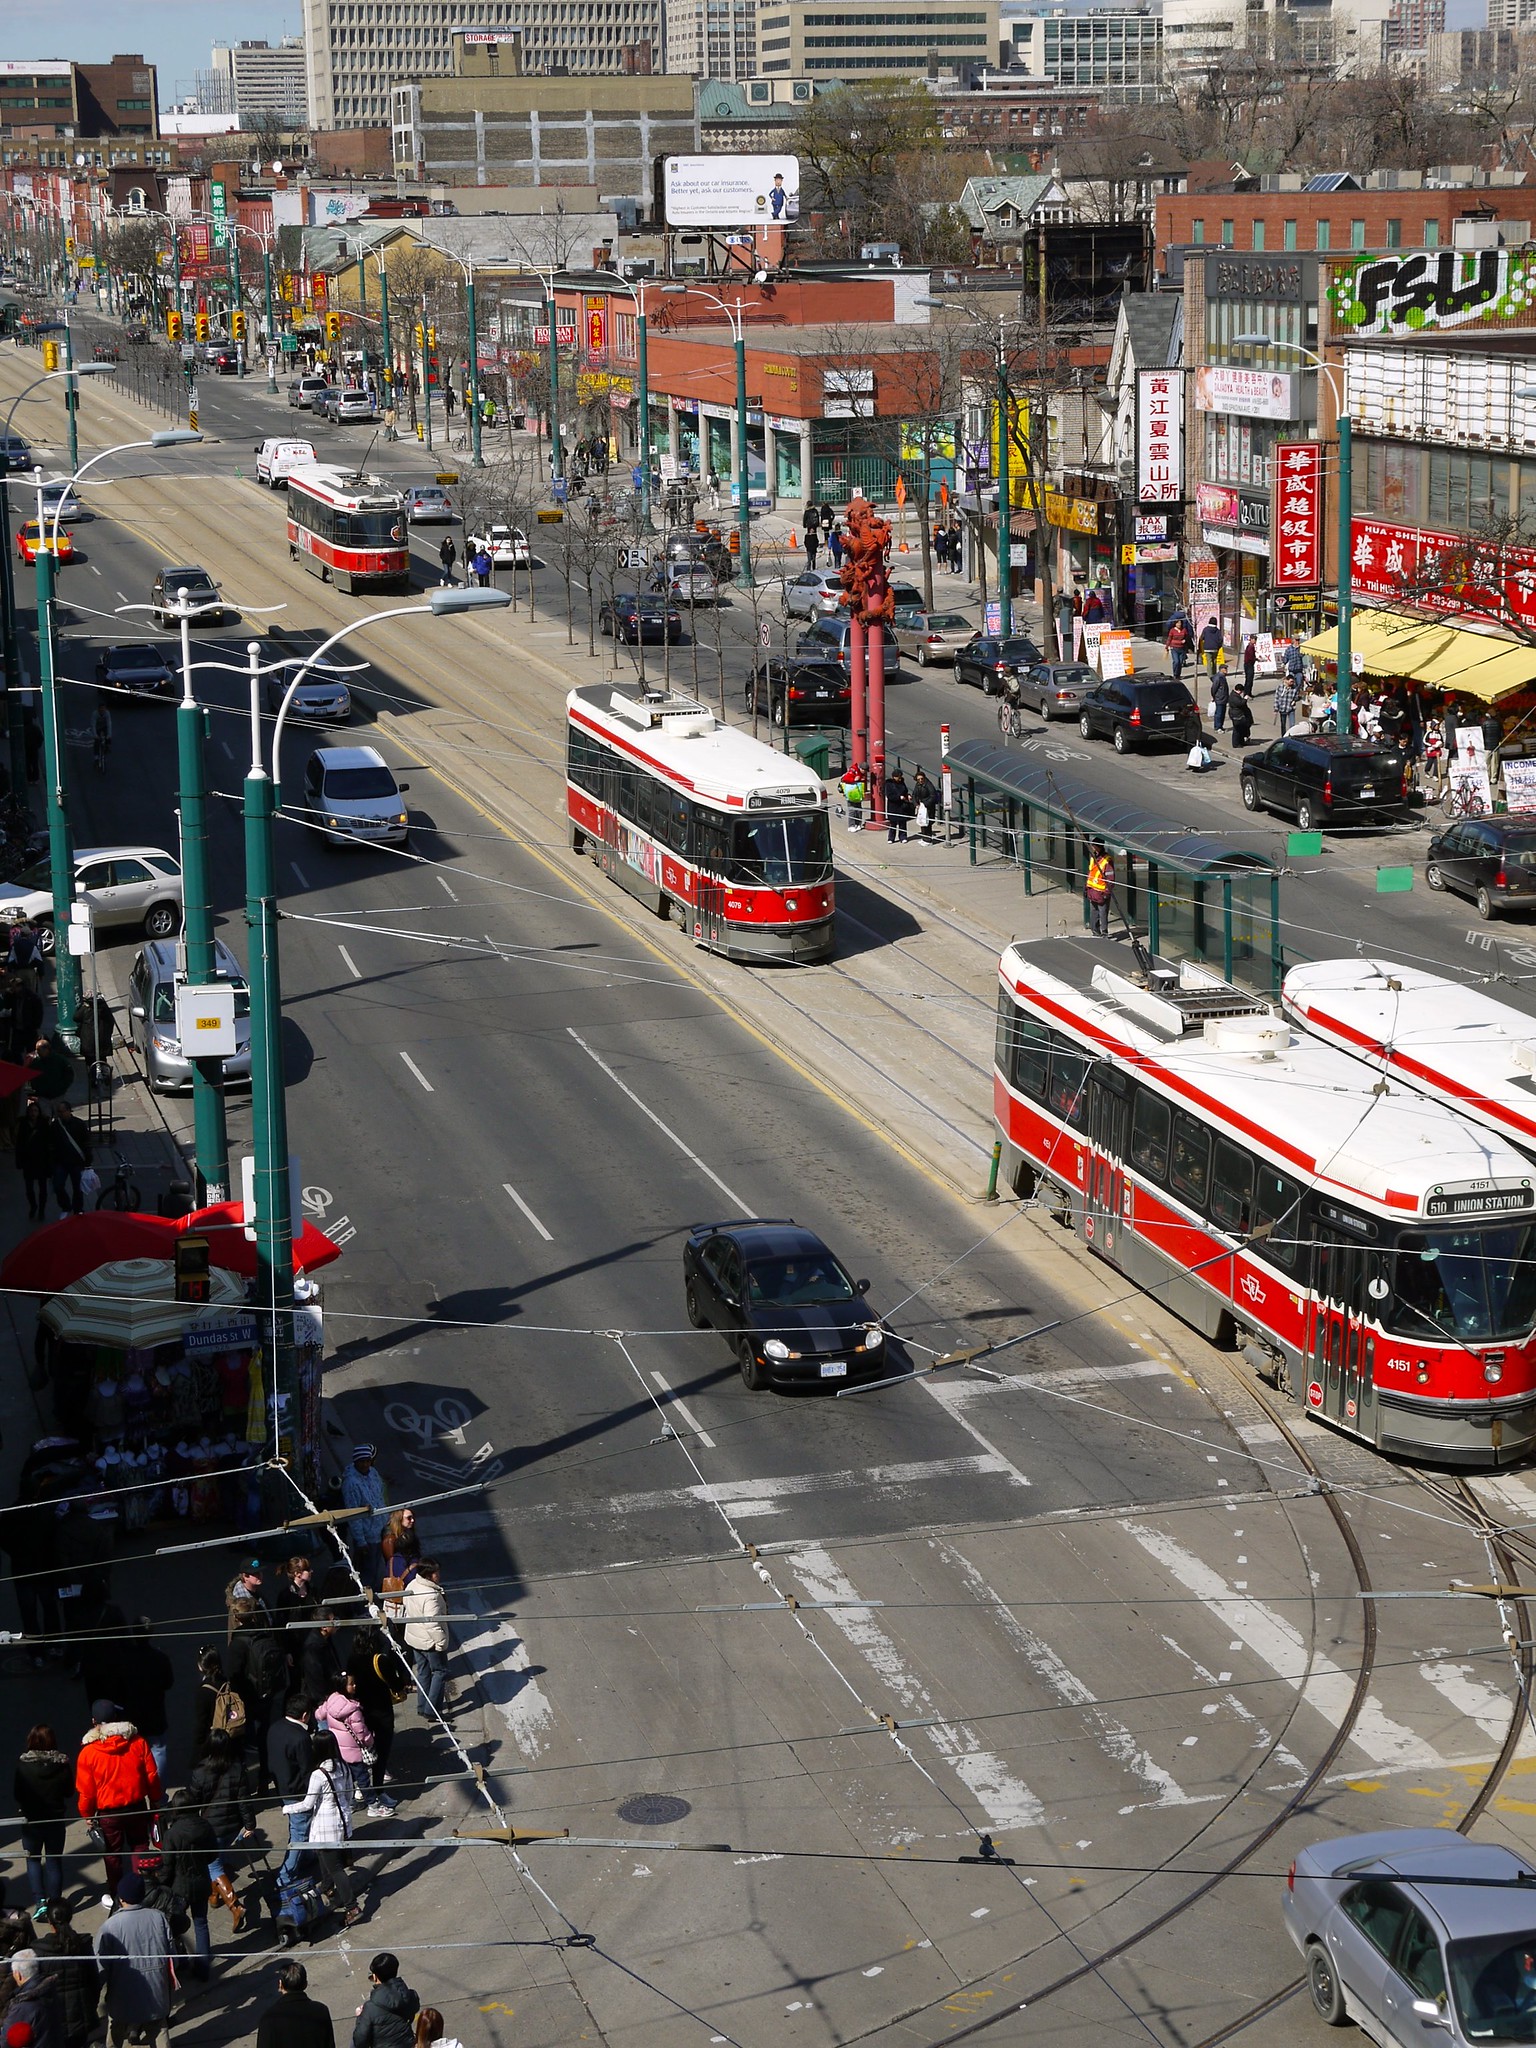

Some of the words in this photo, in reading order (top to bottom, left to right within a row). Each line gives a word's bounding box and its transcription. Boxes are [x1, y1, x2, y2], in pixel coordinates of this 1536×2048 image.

[465, 33, 495, 42] STORAGE
[1280, 451, 1314, 579] 華盛超級市場
[1141, 517, 1161, 525] TAX
[1365, 525, 1387, 536] HUA
[1395, 531, 1435, 544] SHENG
[750, 798, 761, 807] 510
[728, 901, 742, 909] 4079
[200, 1019, 217, 1028] 349
[1470, 1181, 1490, 1190] 4151
[1430, 1202, 1447, 1214] 510
[1454, 1198, 1484, 1212] UNION
[1485, 1195, 1525, 1210] STATION
[189, 1330, 228, 1347] Dundas
[230, 1331, 238, 1341] St
[242, 1328, 251, 1340] W
[1387, 1358, 1411, 1372] 4151
